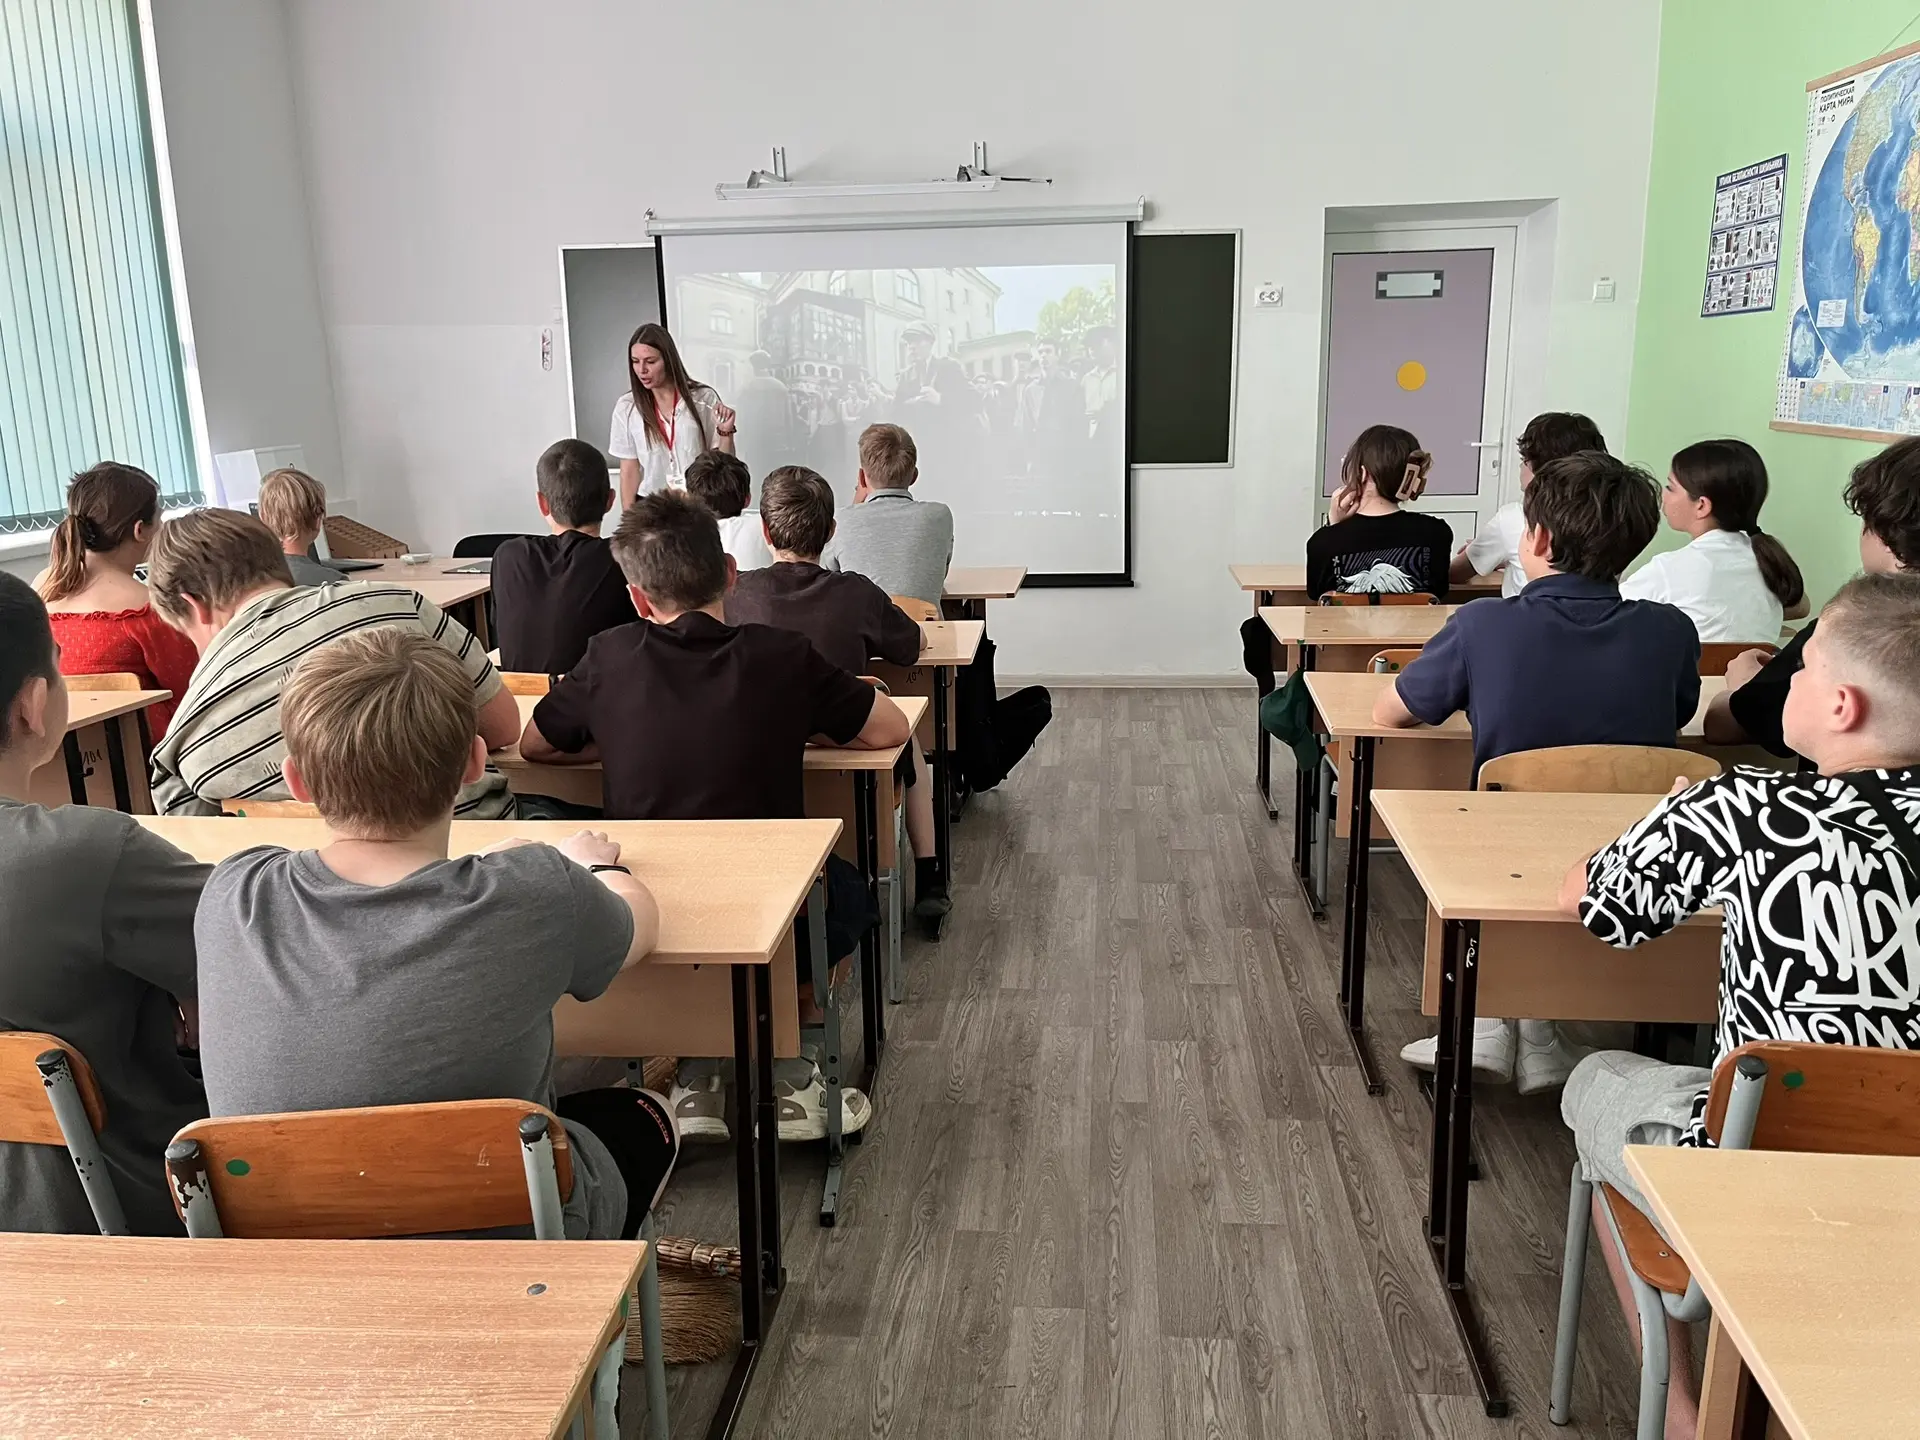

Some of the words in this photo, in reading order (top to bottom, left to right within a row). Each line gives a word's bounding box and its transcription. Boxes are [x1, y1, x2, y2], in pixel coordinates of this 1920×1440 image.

[1820, 86, 1855, 102] ПОЛИТИЧЕСКАЯ
[1820, 101, 1836, 112] КАРТА
[1838, 95, 1854, 108] МИРА
